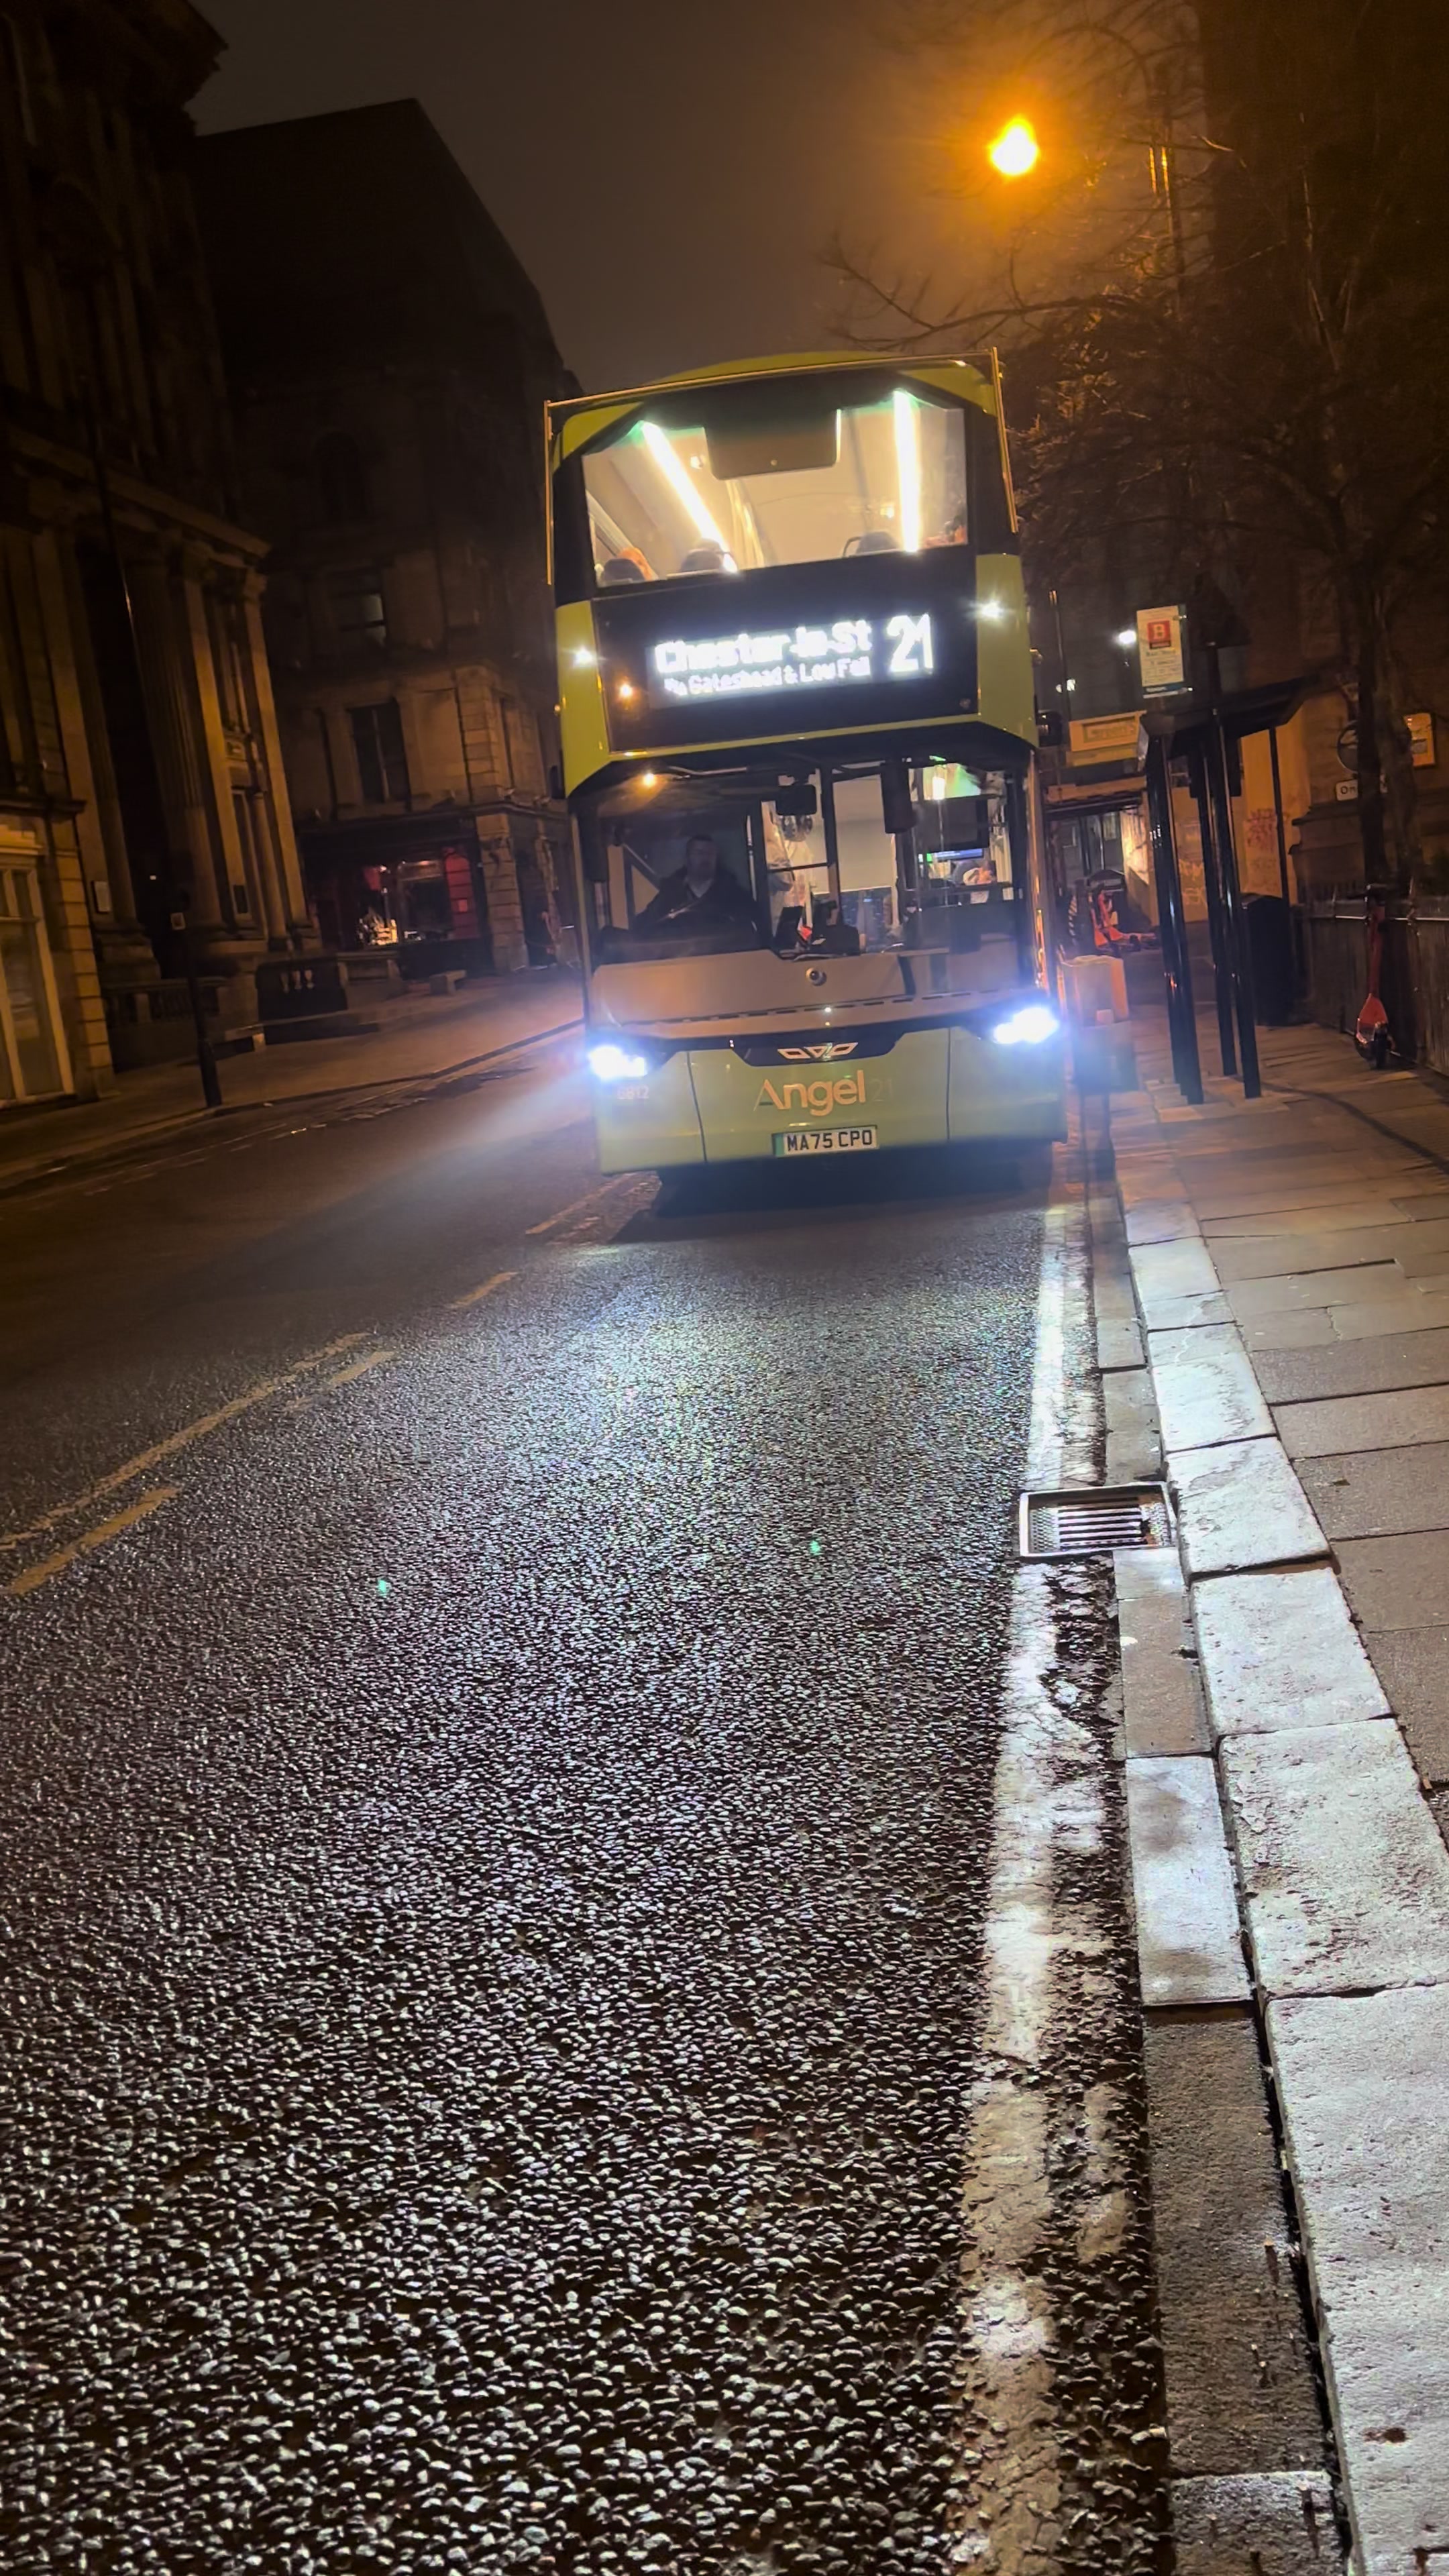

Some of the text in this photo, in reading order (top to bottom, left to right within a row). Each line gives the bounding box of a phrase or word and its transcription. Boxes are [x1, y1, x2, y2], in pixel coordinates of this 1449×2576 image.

[887, 613, 933, 673] 21
[1340, 786, 1357, 795] On
[753, 1069, 865, 1117] Angel
[787, 1129, 873, 1152] MA75 CPO
